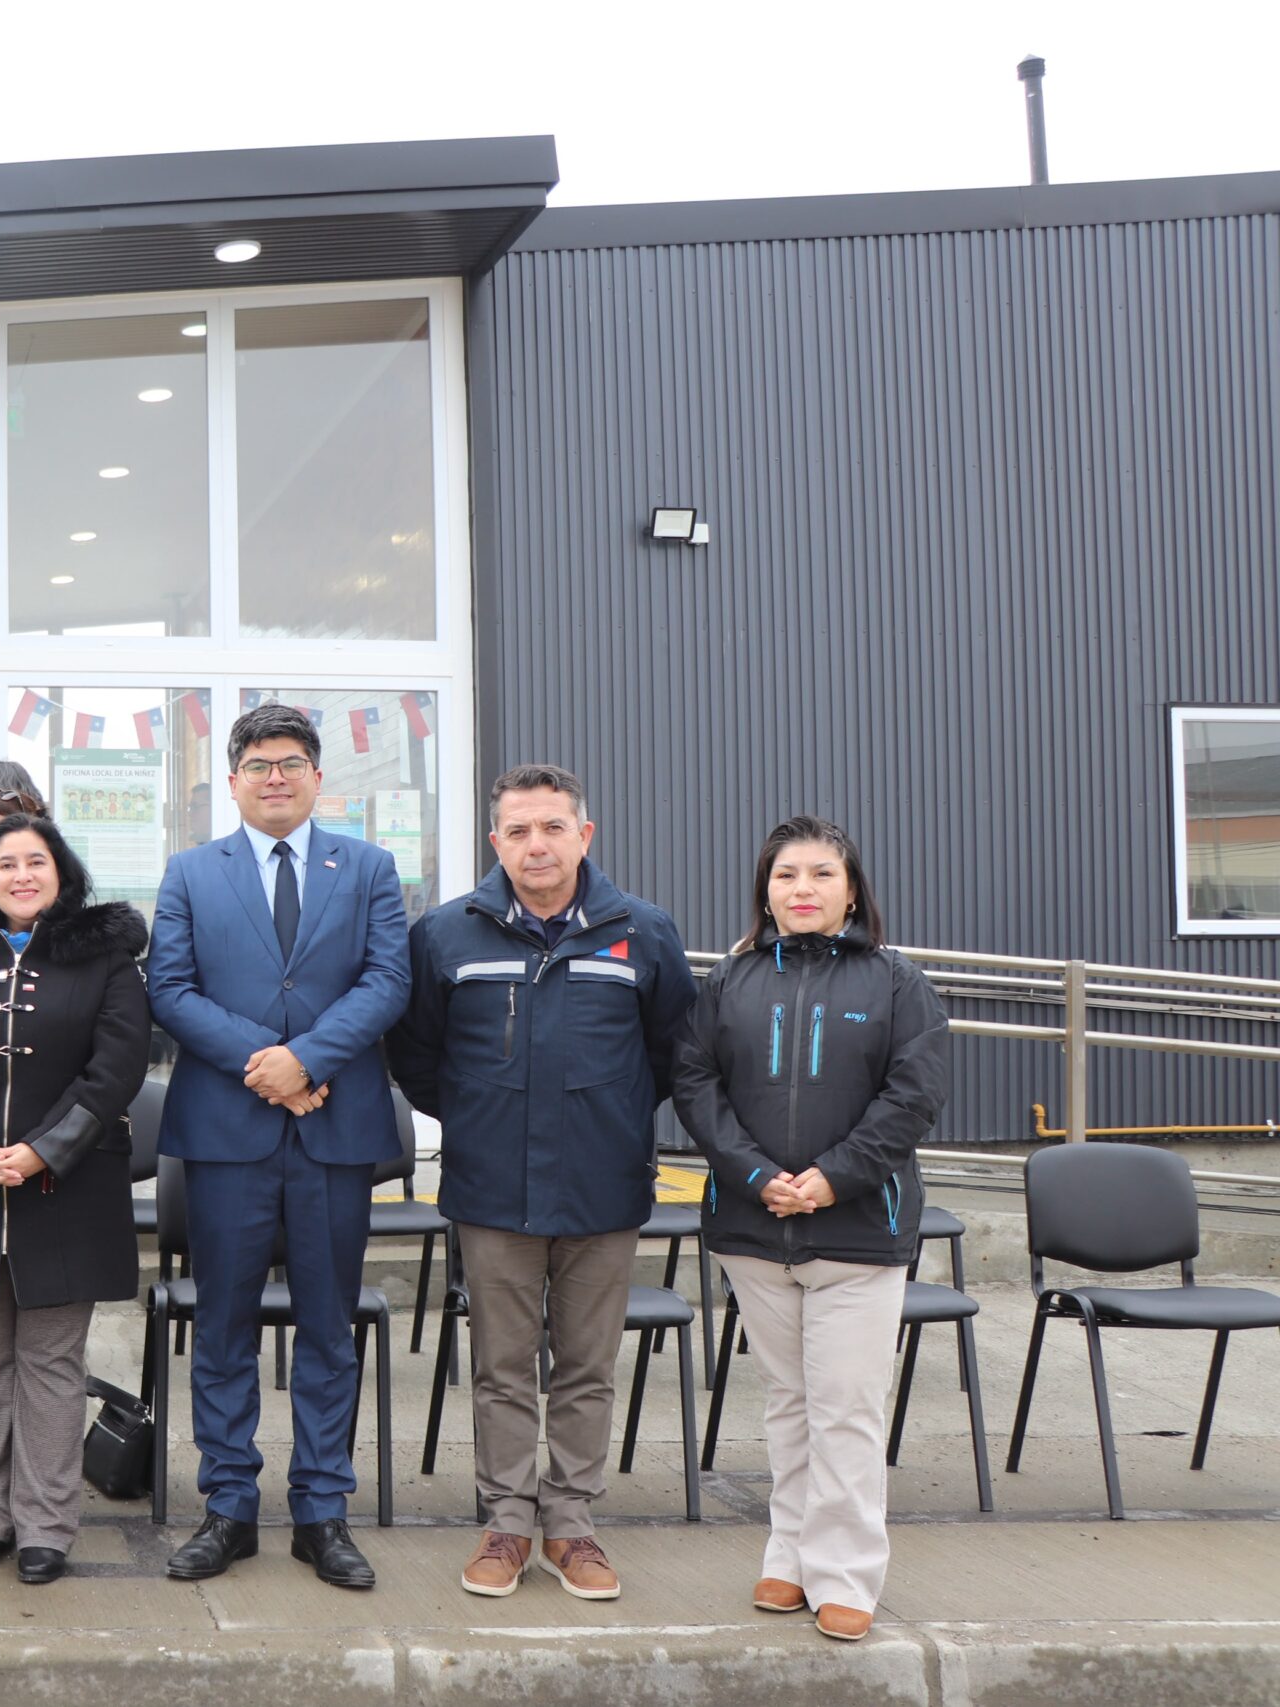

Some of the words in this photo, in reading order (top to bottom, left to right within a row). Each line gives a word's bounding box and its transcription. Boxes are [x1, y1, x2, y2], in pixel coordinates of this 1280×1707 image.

[62, 769, 91, 777] OFICINA
[92, 769, 113, 777] LOCAL
[114, 769, 125, 777] DE
[125, 769, 134, 777] LA
[135, 767, 156, 777] NIÑEZ
